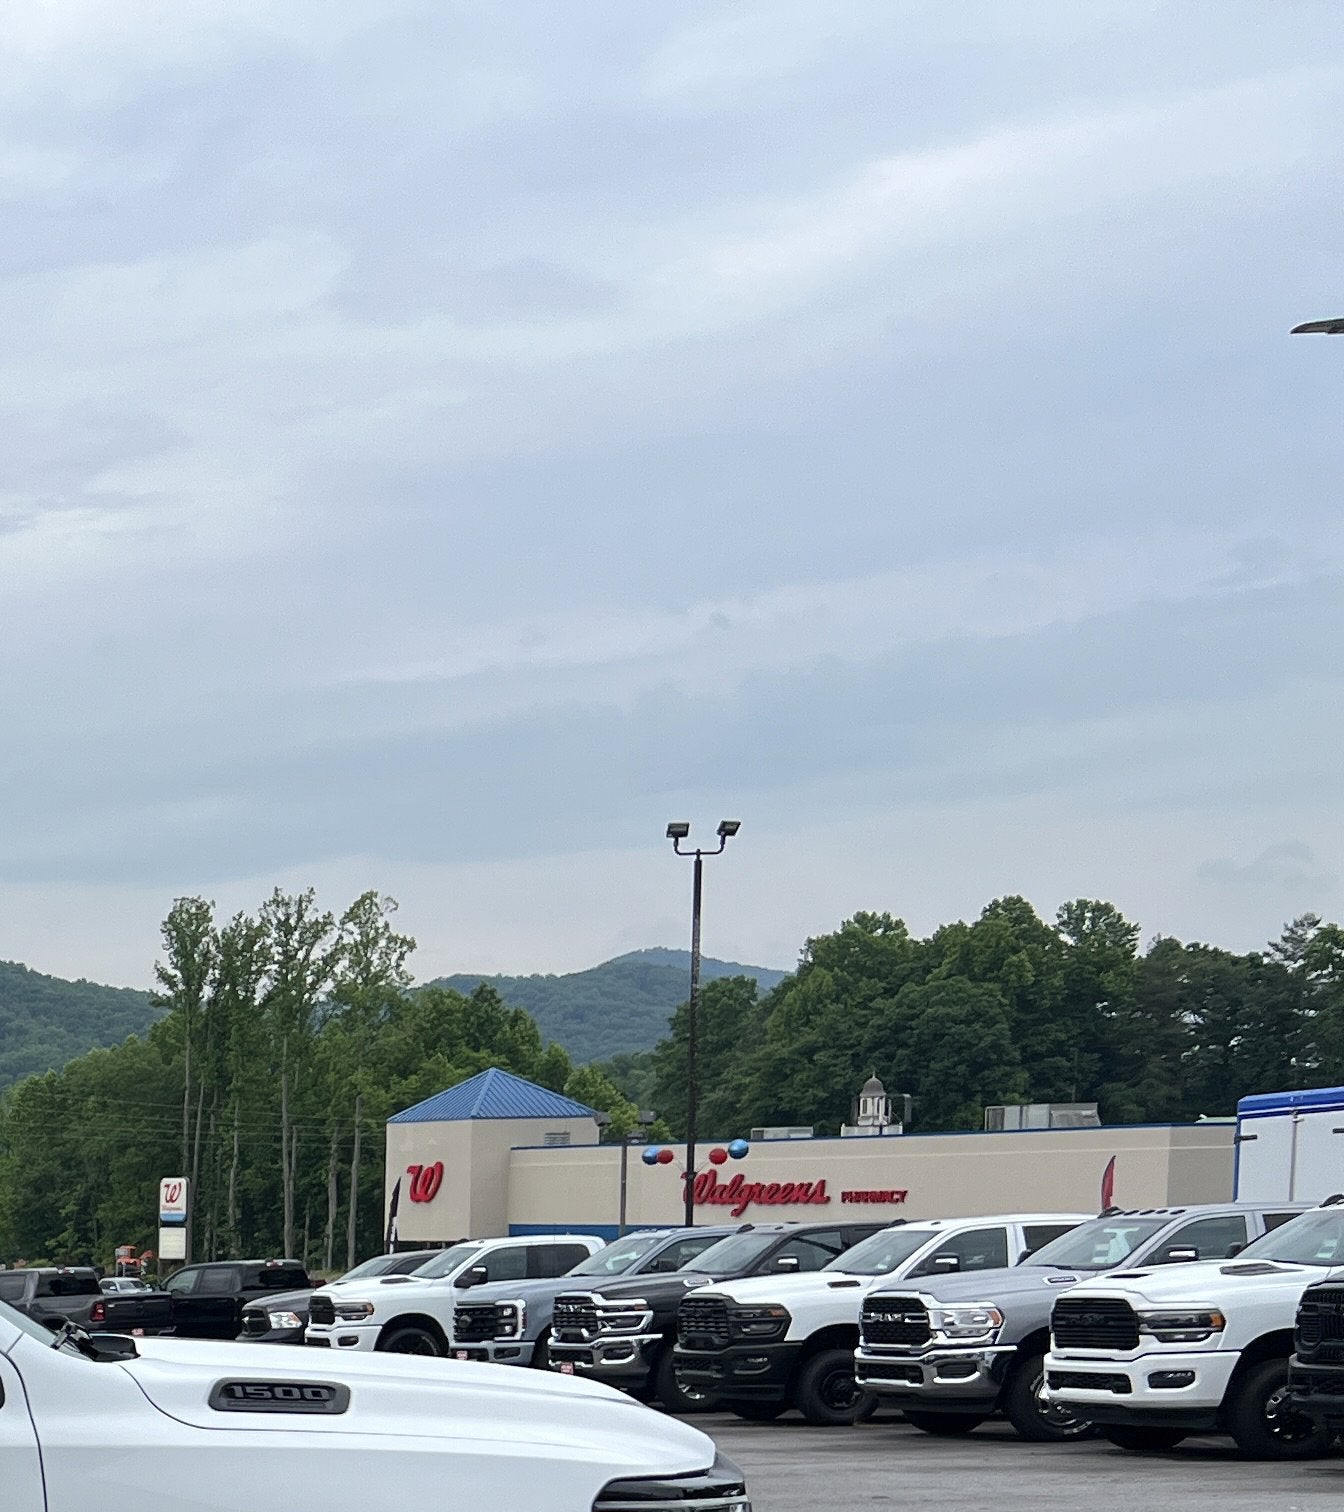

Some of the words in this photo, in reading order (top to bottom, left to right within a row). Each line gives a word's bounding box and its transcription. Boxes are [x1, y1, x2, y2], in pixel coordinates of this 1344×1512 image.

[164, 1182, 182, 1203] W
[407, 1161, 444, 1203] W
[681, 1169, 831, 1217] Walgreens
[227, 1384, 331, 1401] 1500
